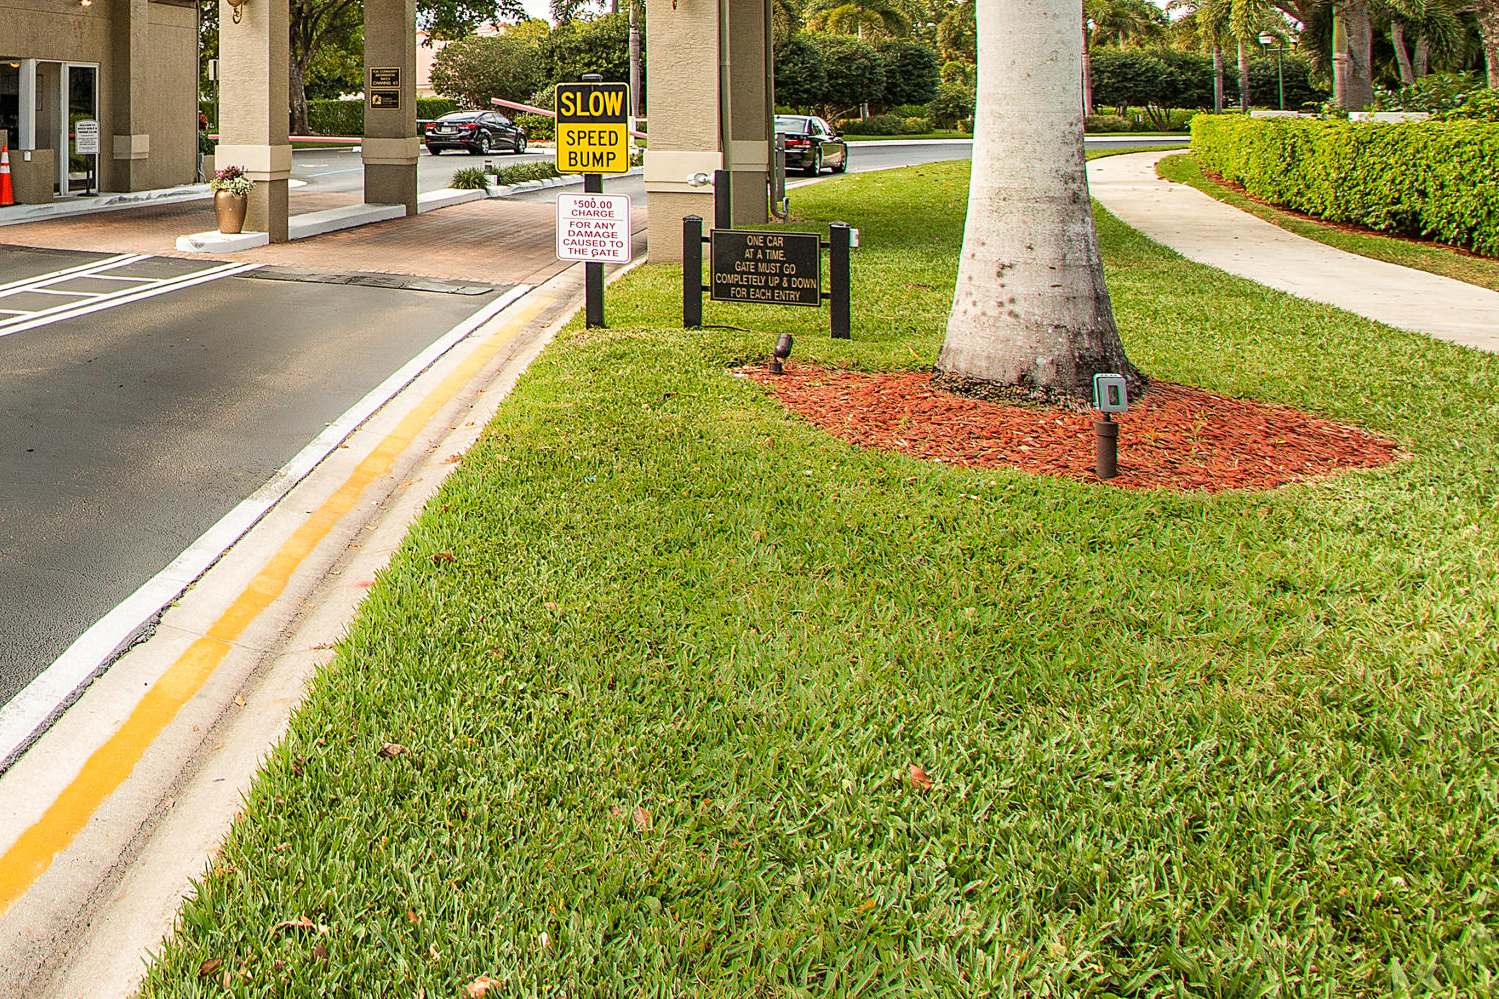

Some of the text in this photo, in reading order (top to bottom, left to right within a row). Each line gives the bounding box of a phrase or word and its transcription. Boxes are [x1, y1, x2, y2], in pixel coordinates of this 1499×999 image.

[560, 91, 624, 117] SLOW
[566, 130, 619, 146] SPEED
[568, 151, 616, 167] BUMP
[573, 199, 612, 209] $500.00
[571, 209, 615, 218] CHARGE
[569, 220, 616, 230] FOR ANY
[567, 229, 619, 239] DAMAGE
[563, 238, 624, 249] CAUSED TO
[746, 235, 784, 247] ONE CAR
[568, 247, 619, 257] THE GATE
[744, 248, 787, 261] AT A TIME.
[734, 260, 797, 275] GATE MUST GO
[715, 272, 817, 289] COMPLETELY UP & DOWN
[730, 287, 801, 301] FOR EACH ENTRY
